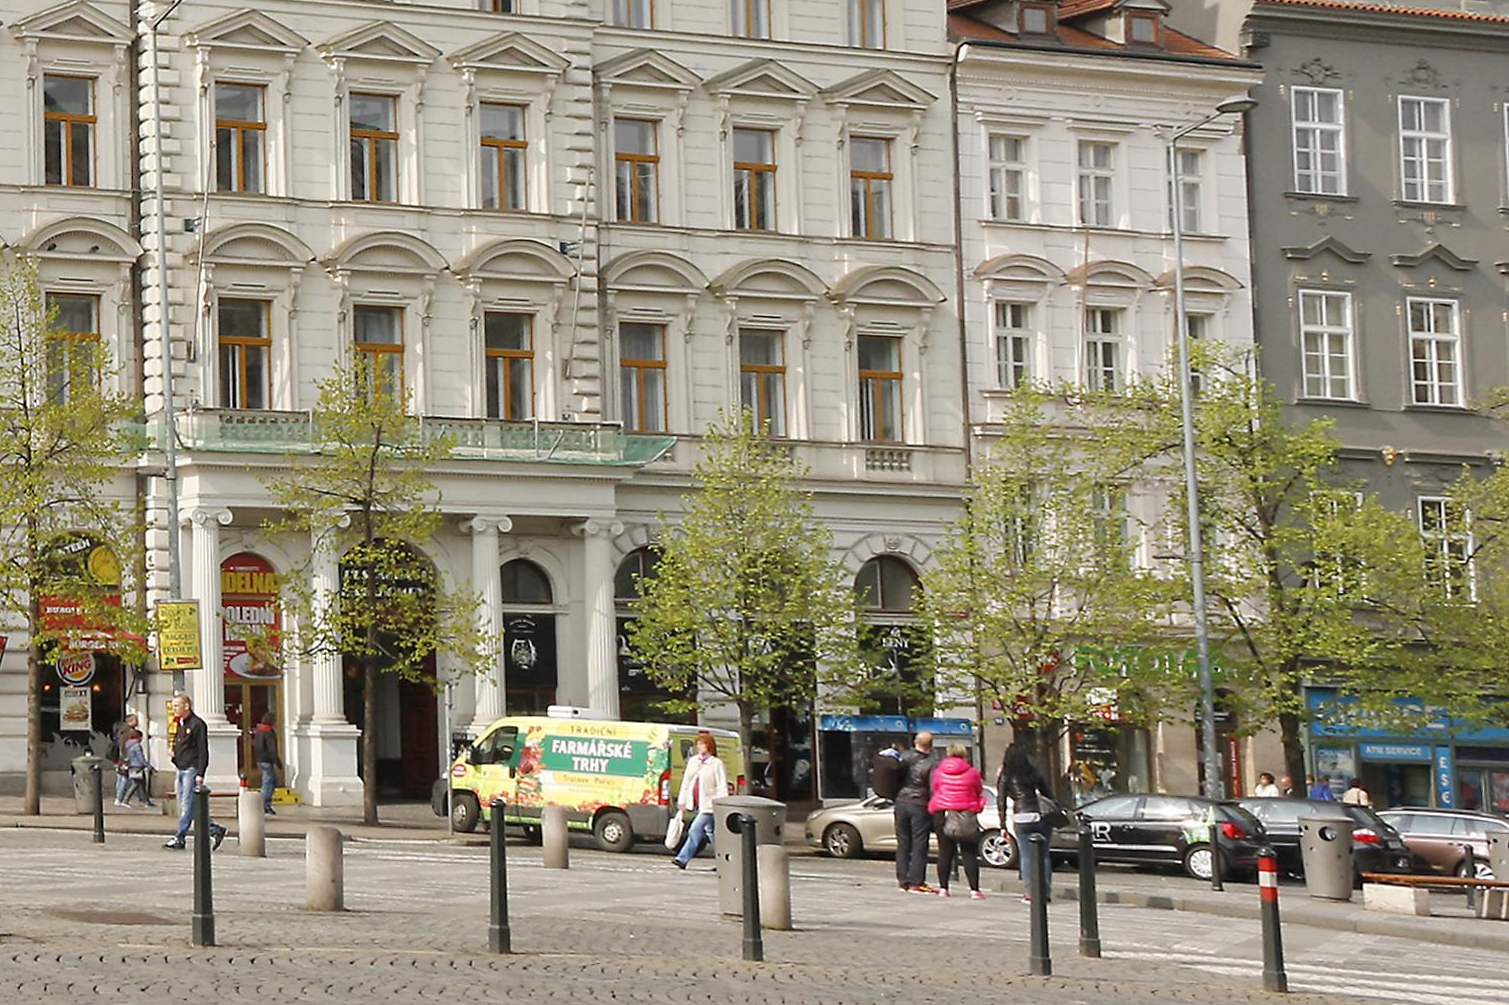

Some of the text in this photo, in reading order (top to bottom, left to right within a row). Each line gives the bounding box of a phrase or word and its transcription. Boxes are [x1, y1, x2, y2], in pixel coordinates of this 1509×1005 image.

[63, 658, 92, 675] KING
[552, 739, 632, 758] FARMÁŘSKÉ
[572, 757, 609, 773] TRHY
